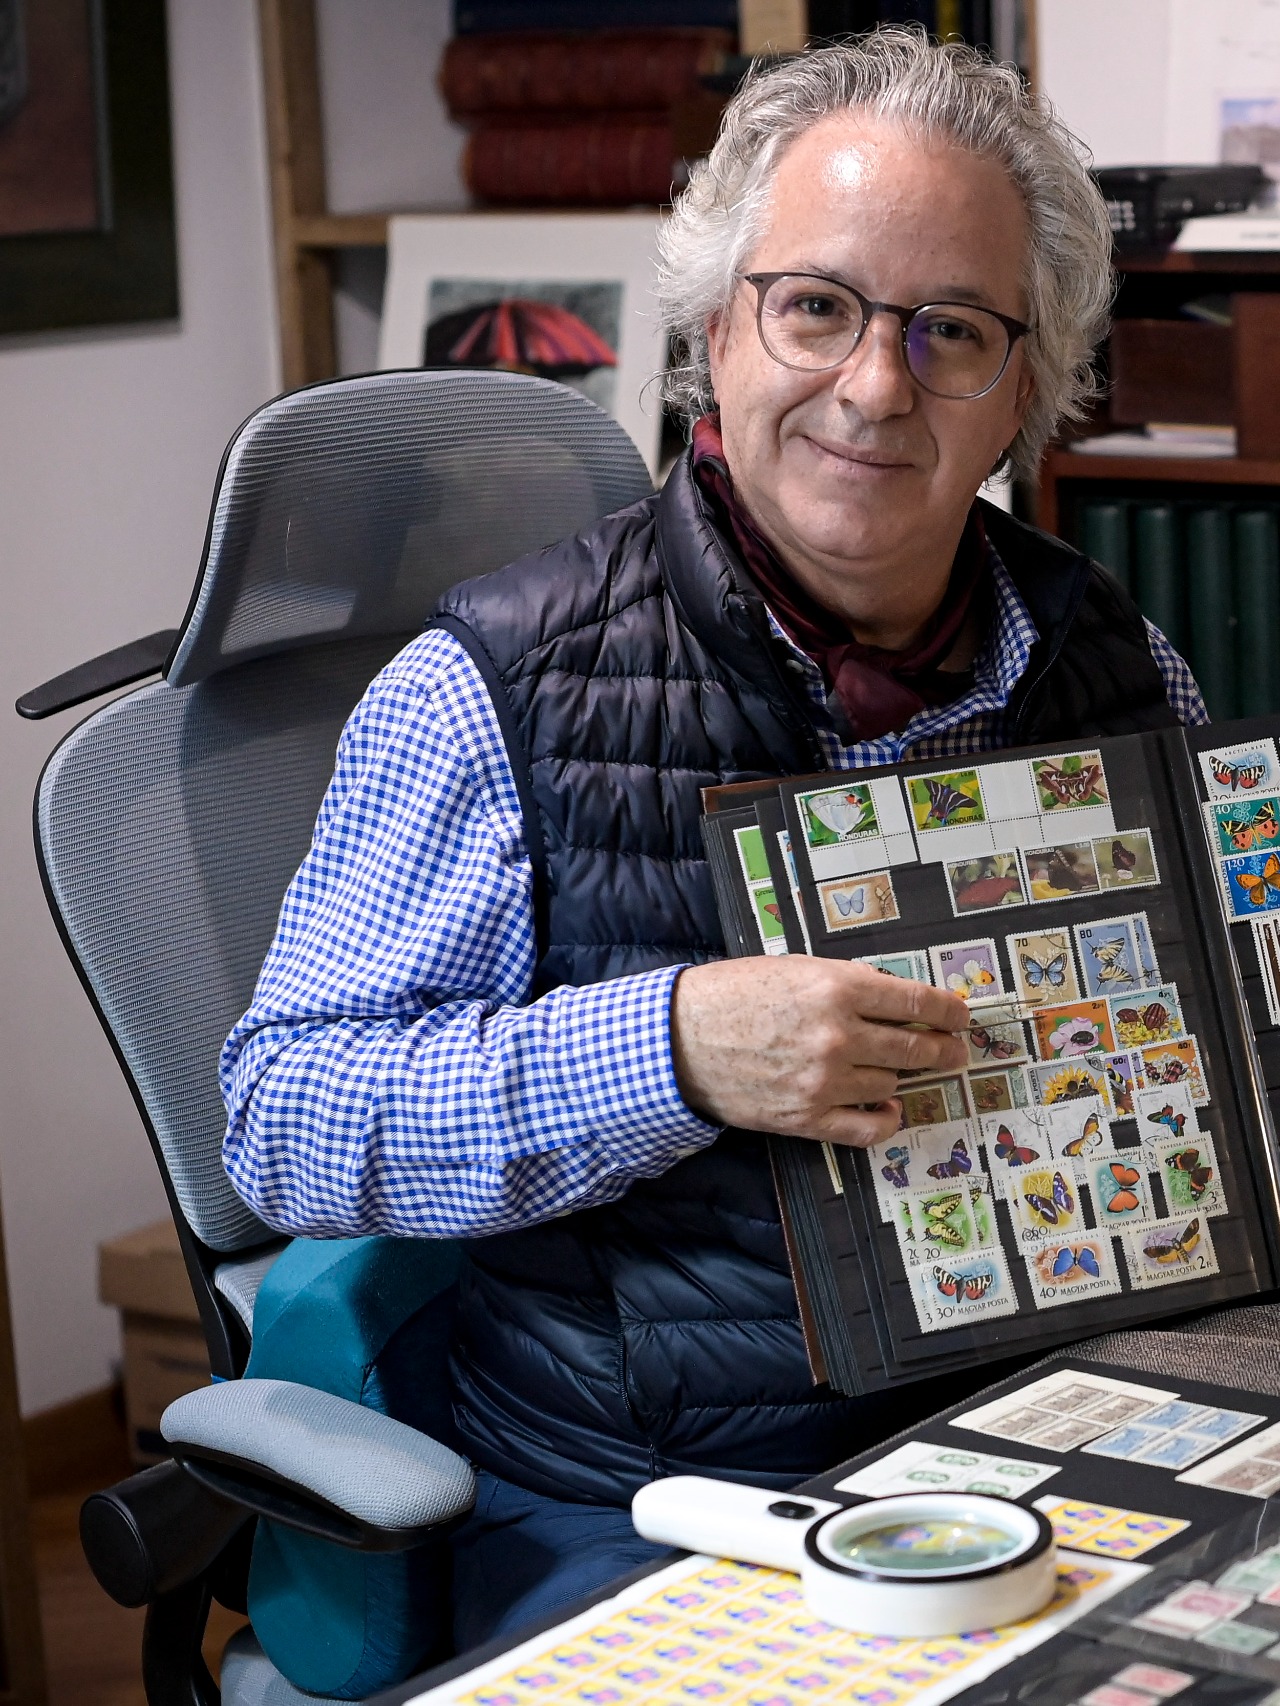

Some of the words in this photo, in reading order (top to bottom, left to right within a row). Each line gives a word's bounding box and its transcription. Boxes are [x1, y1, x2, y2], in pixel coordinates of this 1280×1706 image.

[943, 813, 985, 826] HONDURAS
[1209, 804, 1219, 830] POSTA
[838, 828, 879, 843] HONDURAS
[1024, 846, 1056, 856] HONDURAS
[947, 859, 979, 868] HONDURAS
[1219, 859, 1229, 885] POSTA
[1224, 884, 1236, 917] MAGYAR
[1079, 928, 1094, 940] 80
[1015, 937, 1029, 949] 70
[939, 950, 954, 963] 60
[1029, 1069, 1039, 1092] POSTA
[1146, 1268, 1175, 1283] MAGYAR
[1175, 1264, 1197, 1275] POSTA
[1060, 1283, 1090, 1297] MAGYAR
[1089, 1279, 1111, 1290] POSTA
[957, 1302, 987, 1316] MAGYAR
[987, 1297, 1009, 1309] POSTA
